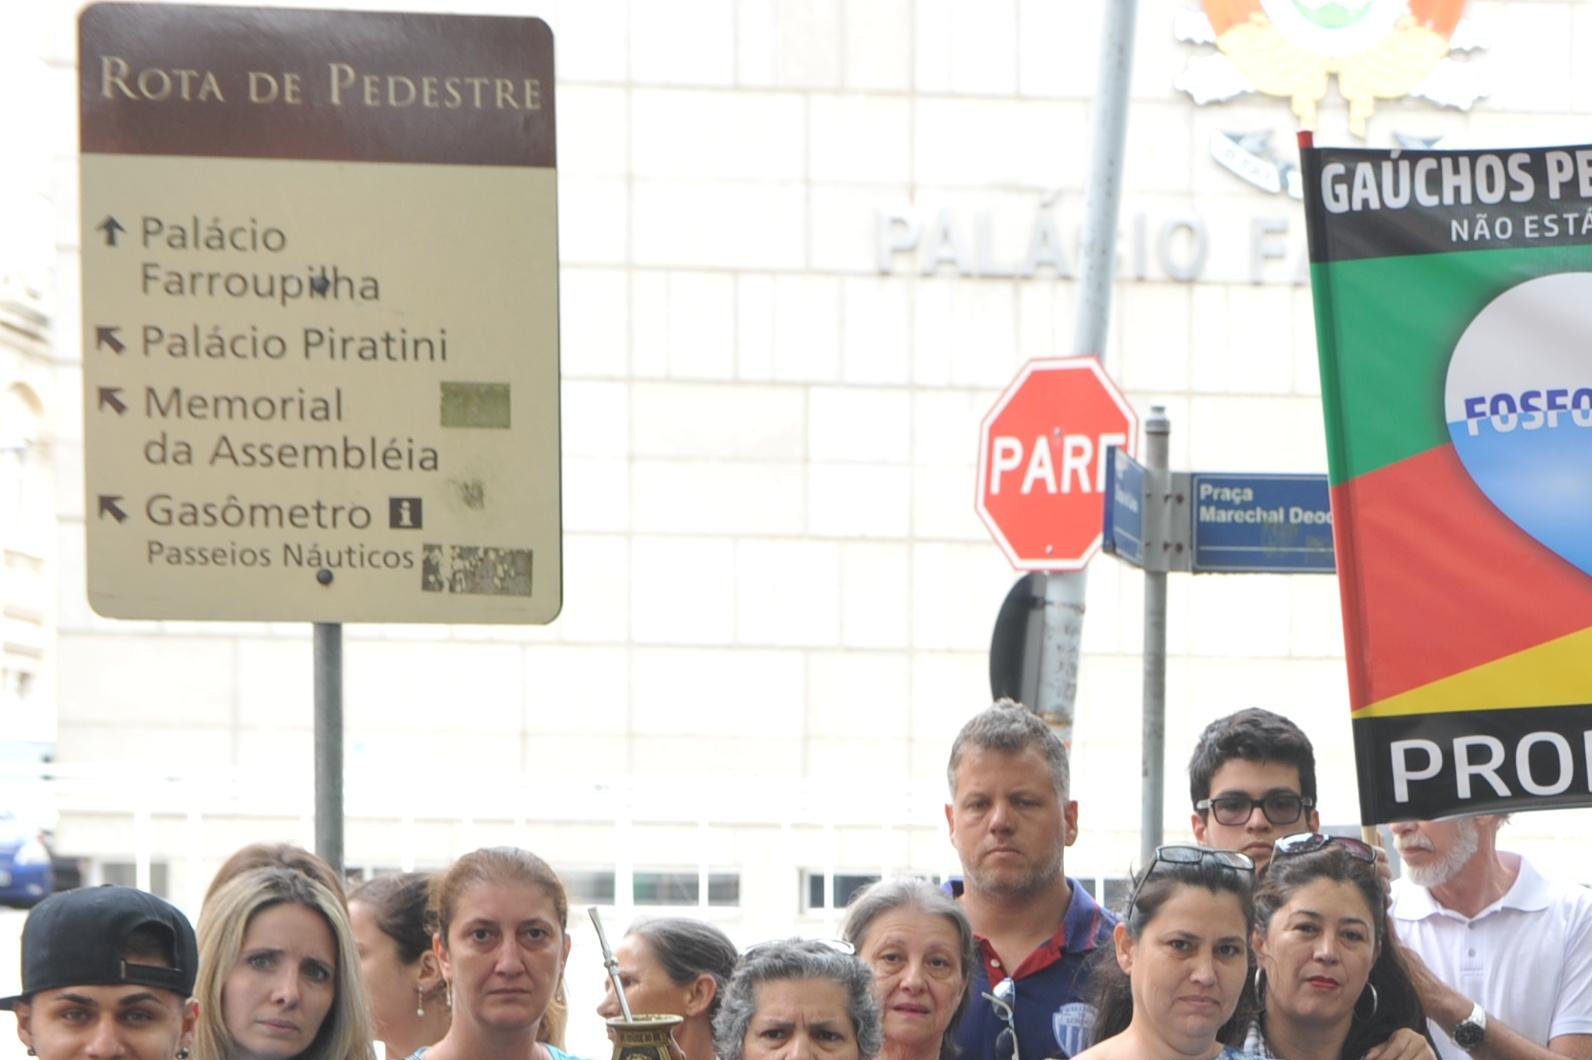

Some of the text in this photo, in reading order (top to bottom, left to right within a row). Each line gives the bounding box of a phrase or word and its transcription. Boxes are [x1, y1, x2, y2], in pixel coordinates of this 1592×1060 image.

[100, 56, 542, 110] ROTA DE PEDESTRE
[1321, 148, 1535, 214] GAÚCHOS
[142, 216, 287, 254] Palácio
[875, 189, 1209, 285] PALÁIO
[1451, 212, 1513, 242] NÃO
[142, 262, 381, 306] Farroupilha
[142, 325, 448, 362] Palácio Piratini
[144, 385, 344, 422] Memorial
[144, 432, 439, 472] da Assembléia
[145, 494, 371, 529] Gasômetro
[1200, 484, 1253, 504] Praça
[1200, 506, 1284, 523] Marechal
[147, 541, 414, 571] Passeios Náuticos
